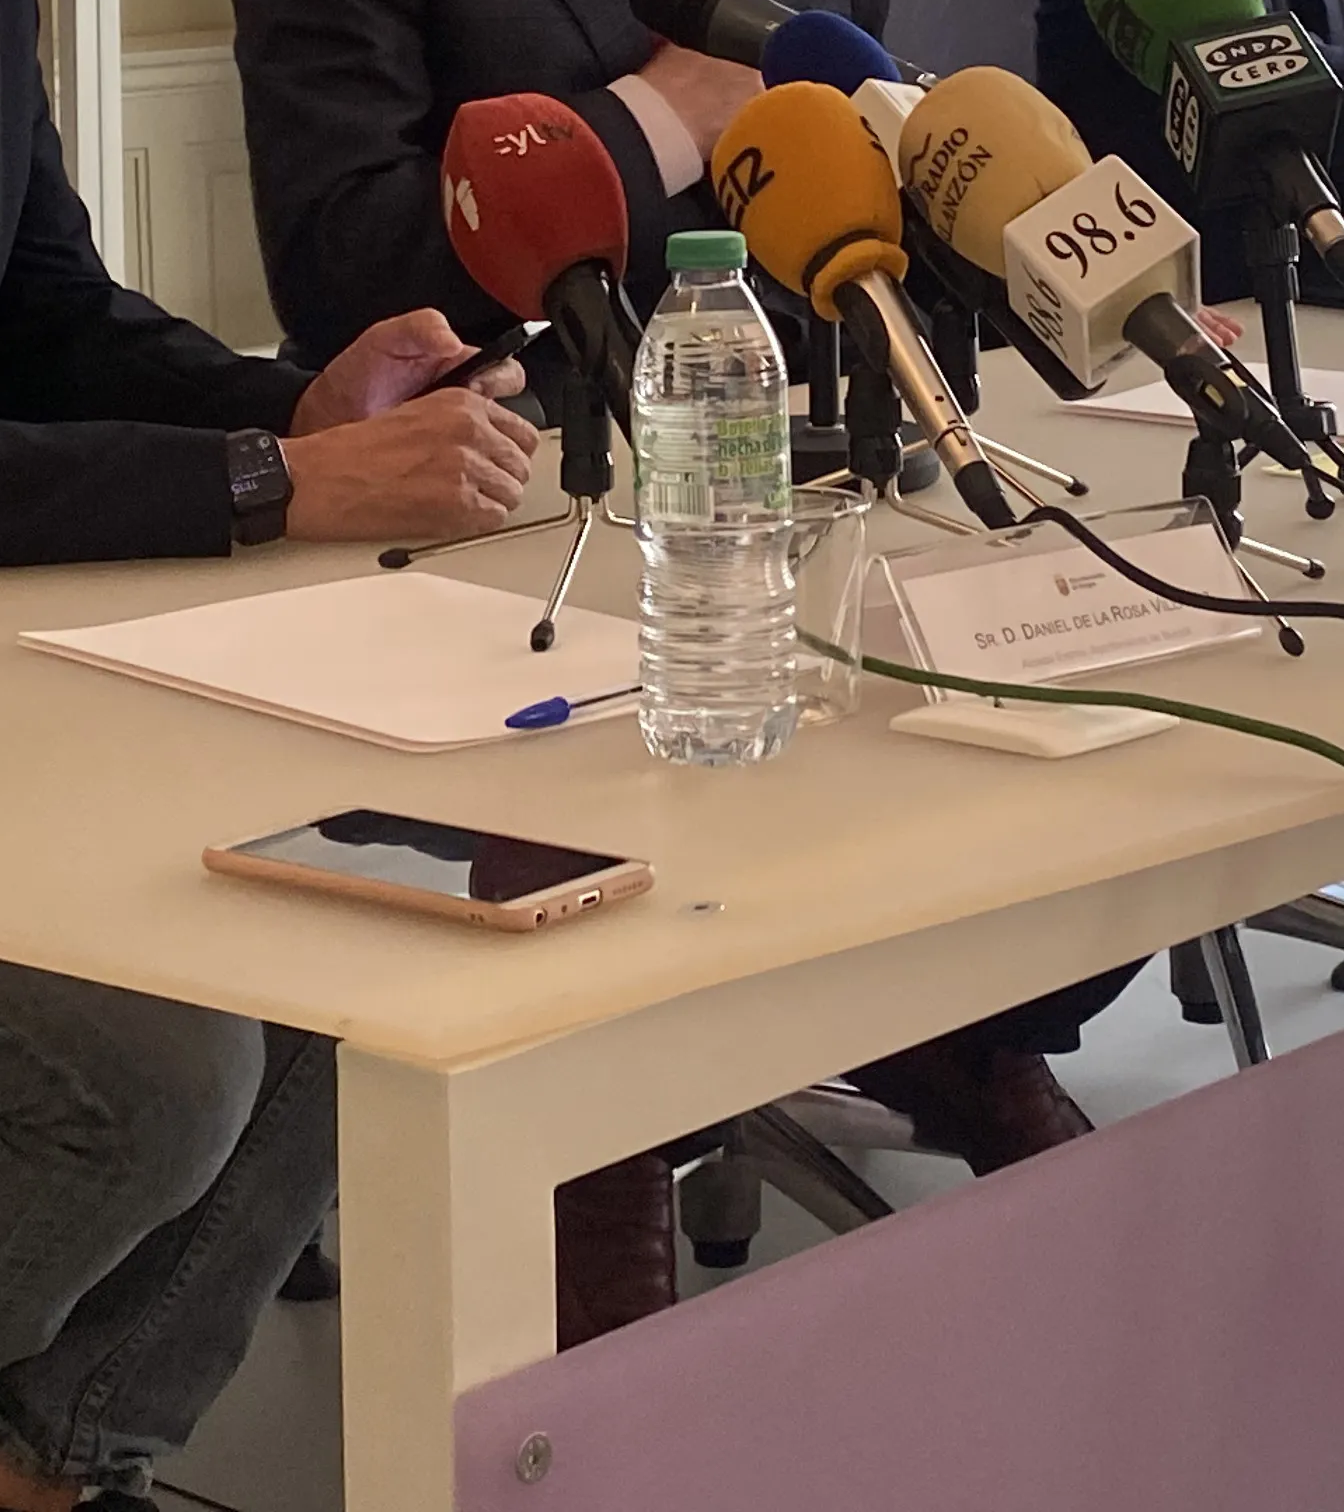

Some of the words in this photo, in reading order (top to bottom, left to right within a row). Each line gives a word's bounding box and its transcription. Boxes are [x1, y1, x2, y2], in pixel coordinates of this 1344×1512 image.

[1212, 38, 1286, 63] ONDA
[1230, 58, 1297, 83] CERO
[920, 126, 969, 200] RADIO
[1045, 180, 1157, 279] 98.6
[1021, 619, 1072, 640] DANIEL
[1072, 614, 1093, 630] DE
[1095, 611, 1113, 626] LA
[1111, 601, 1151, 623] ROSA
